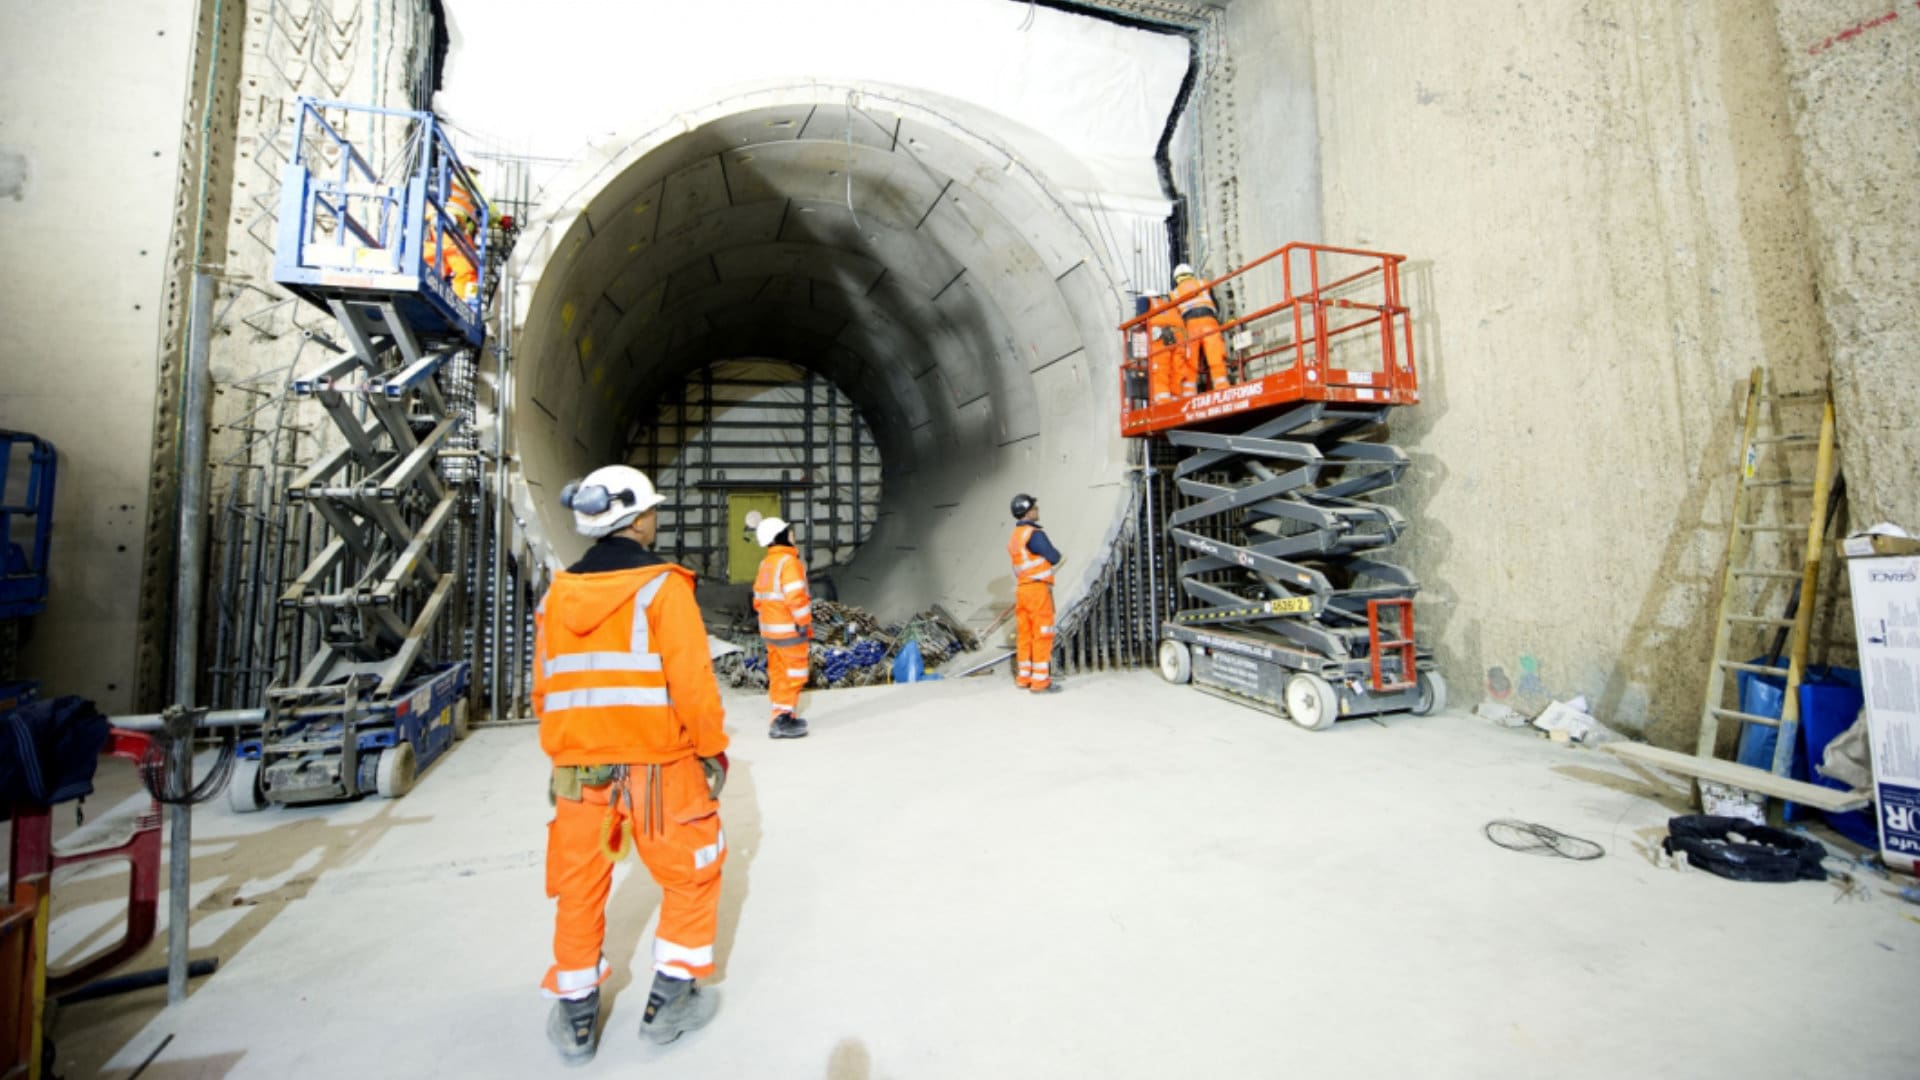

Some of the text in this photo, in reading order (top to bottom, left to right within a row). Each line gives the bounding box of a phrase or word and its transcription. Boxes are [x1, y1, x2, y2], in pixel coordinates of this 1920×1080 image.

[1191, 381, 1264, 410] STAR PLATFORMS
[1888, 836, 1920, 851] ufe
